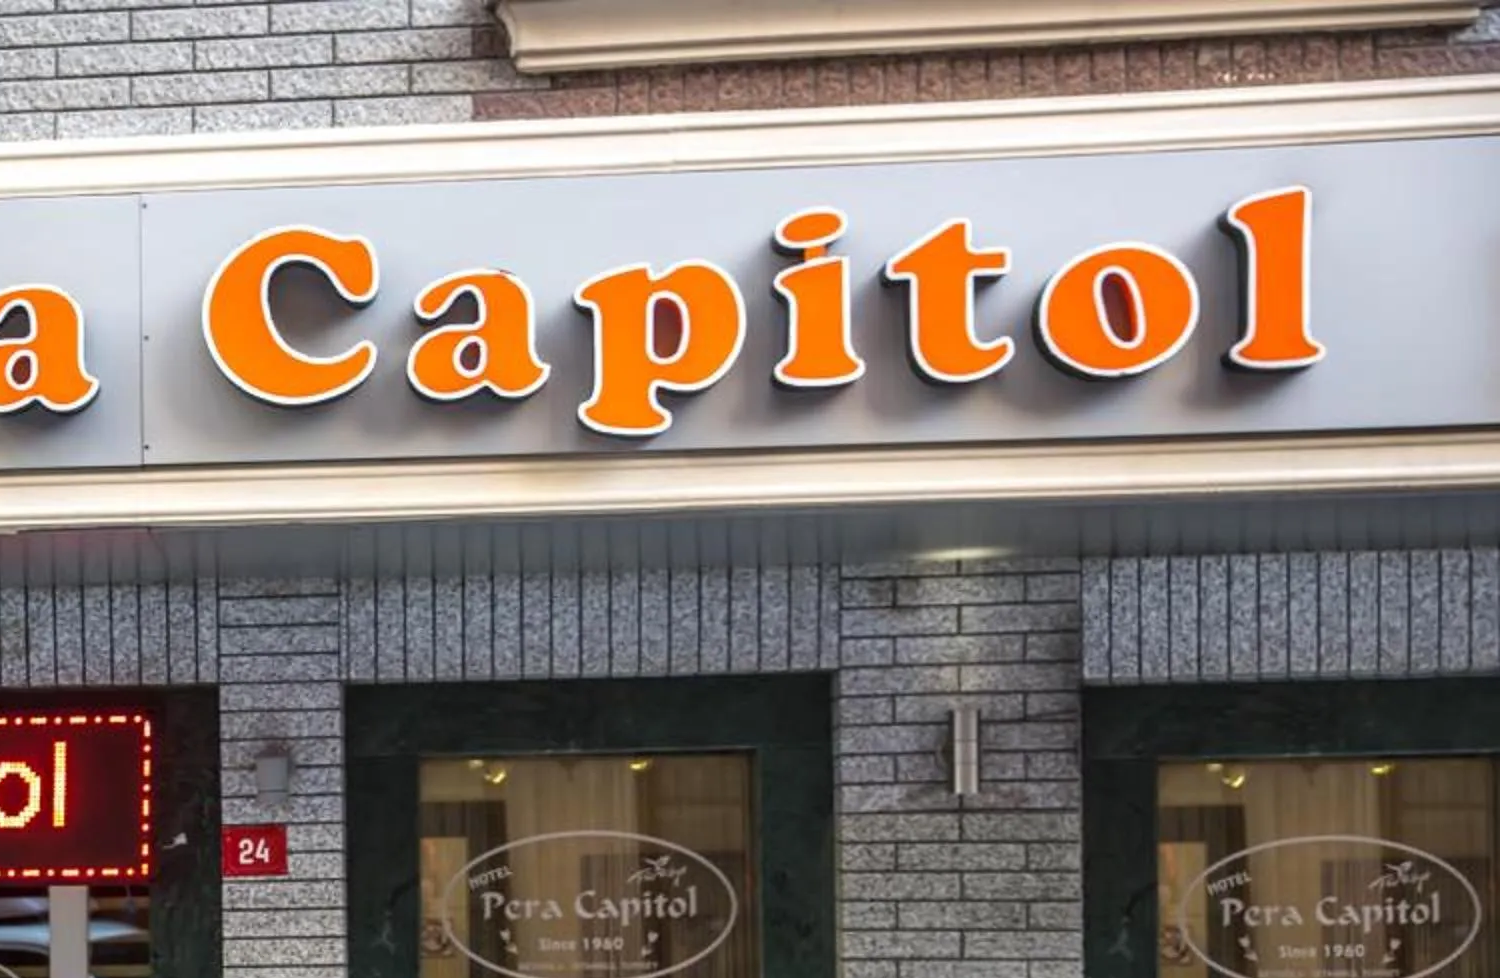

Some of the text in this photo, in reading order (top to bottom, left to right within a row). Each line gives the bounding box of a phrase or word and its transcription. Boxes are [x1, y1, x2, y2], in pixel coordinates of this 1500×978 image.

[203, 187, 1322, 438] Capitol
[238, 837, 270, 865] 24
[468, 865, 513, 891] HOTEL
[1207, 871, 1253, 896] HOTEL
[481, 885, 699, 927] Pera Capitol
[1219, 892, 1441, 935] Pera Capitol
